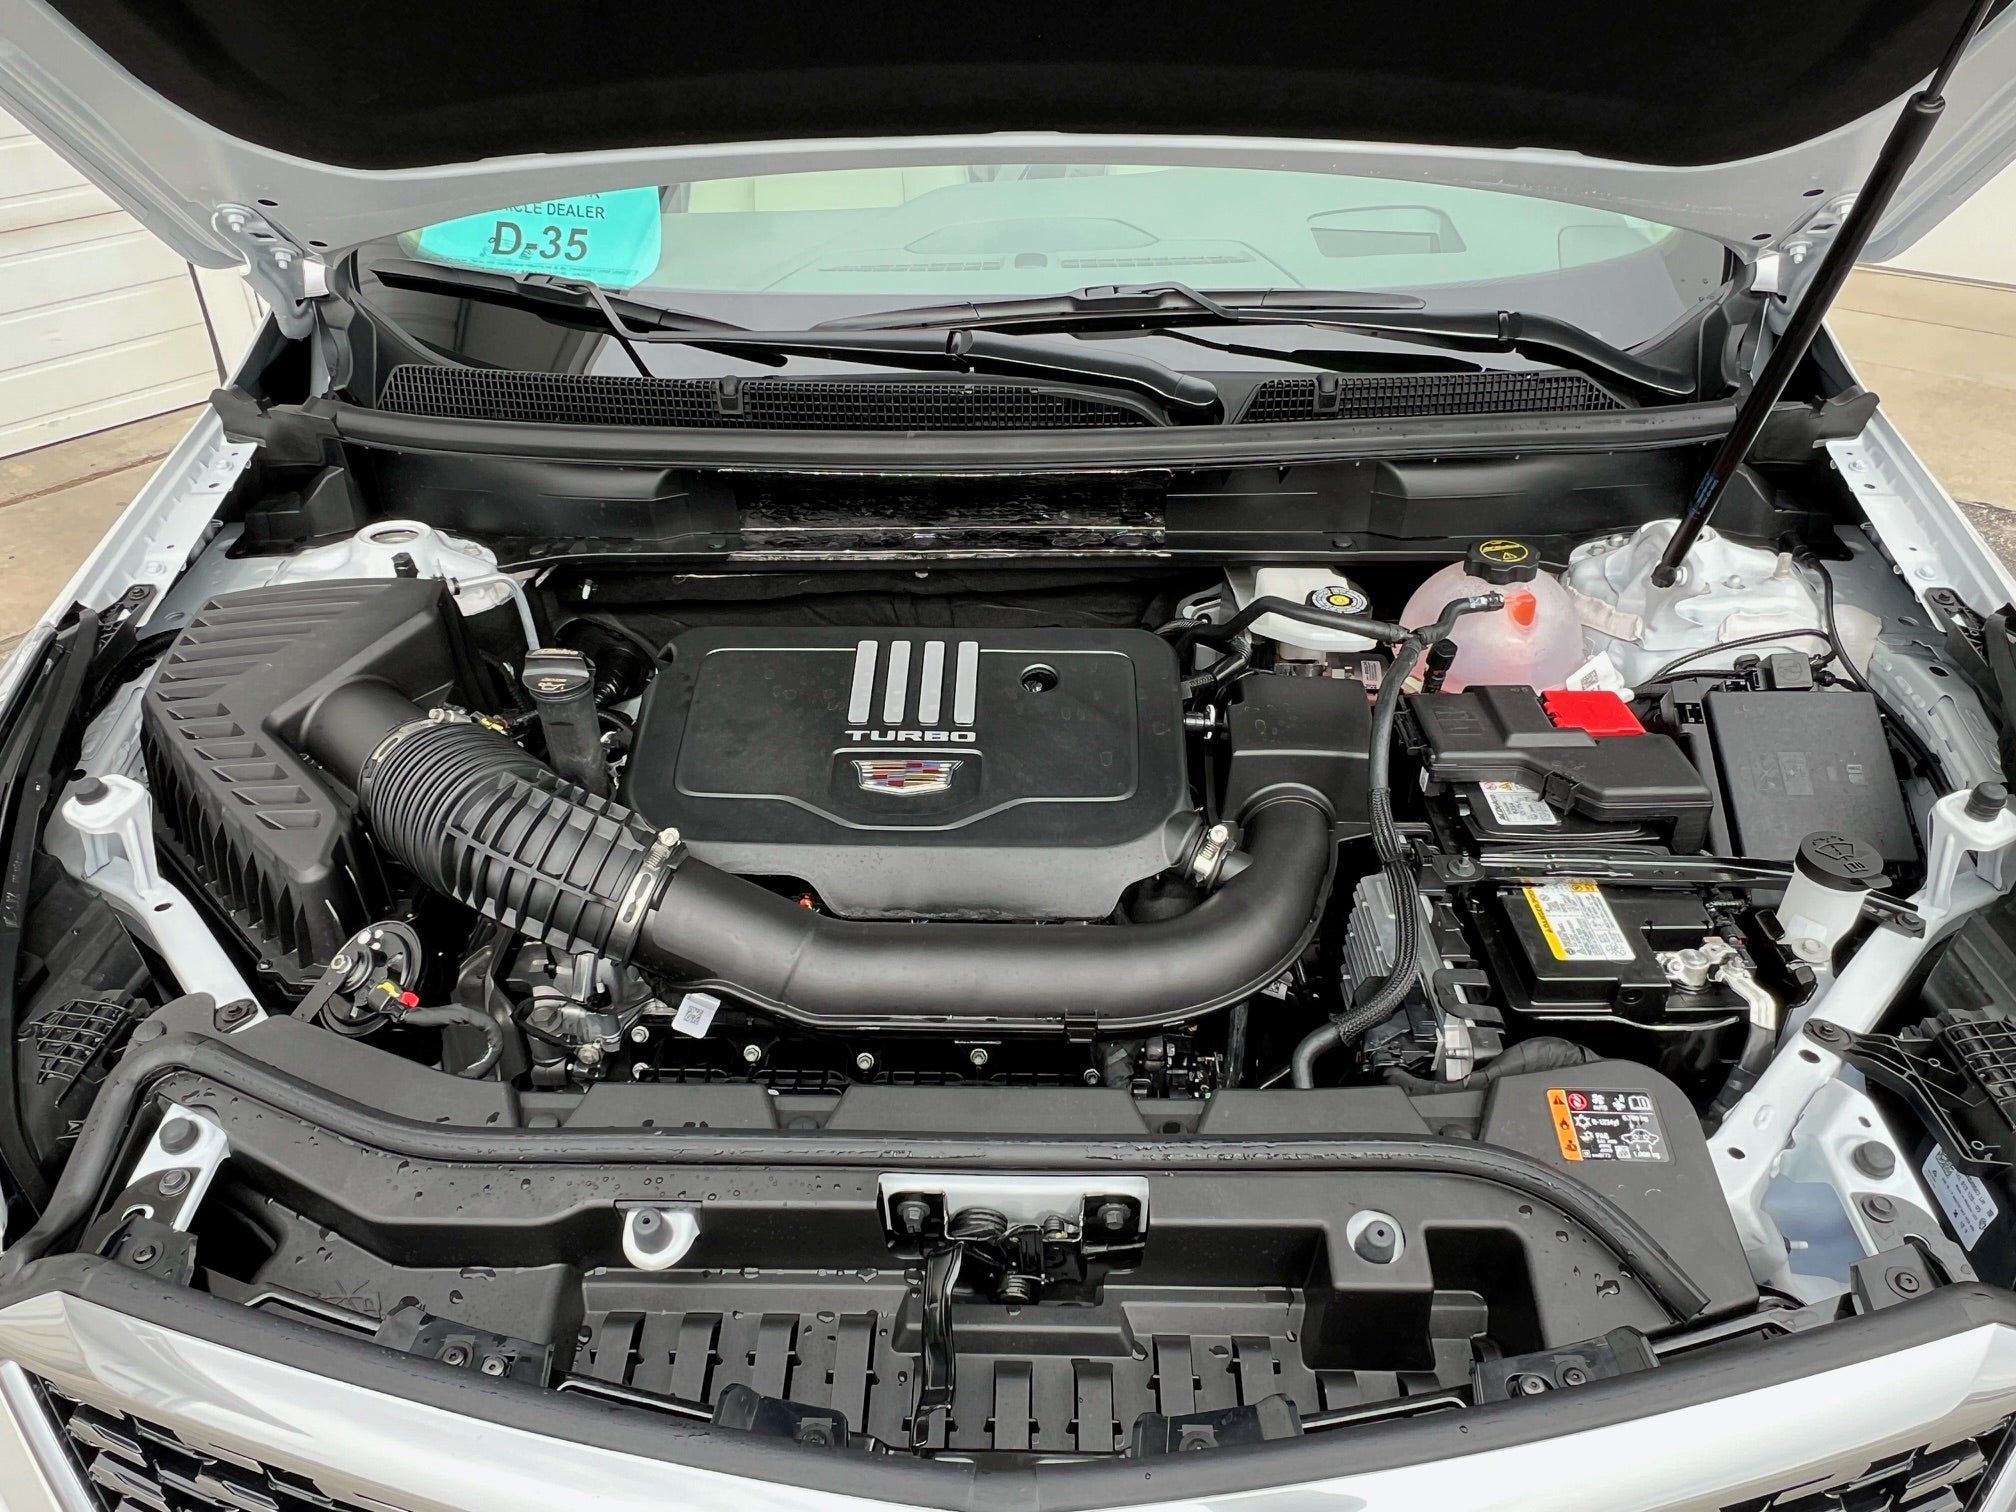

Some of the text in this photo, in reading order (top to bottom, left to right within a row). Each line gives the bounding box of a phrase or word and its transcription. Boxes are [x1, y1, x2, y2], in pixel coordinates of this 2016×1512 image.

[547, 203, 605, 219] DEALER
[491, 221, 588, 261] D-35
[845, 730, 976, 742] TURBO
